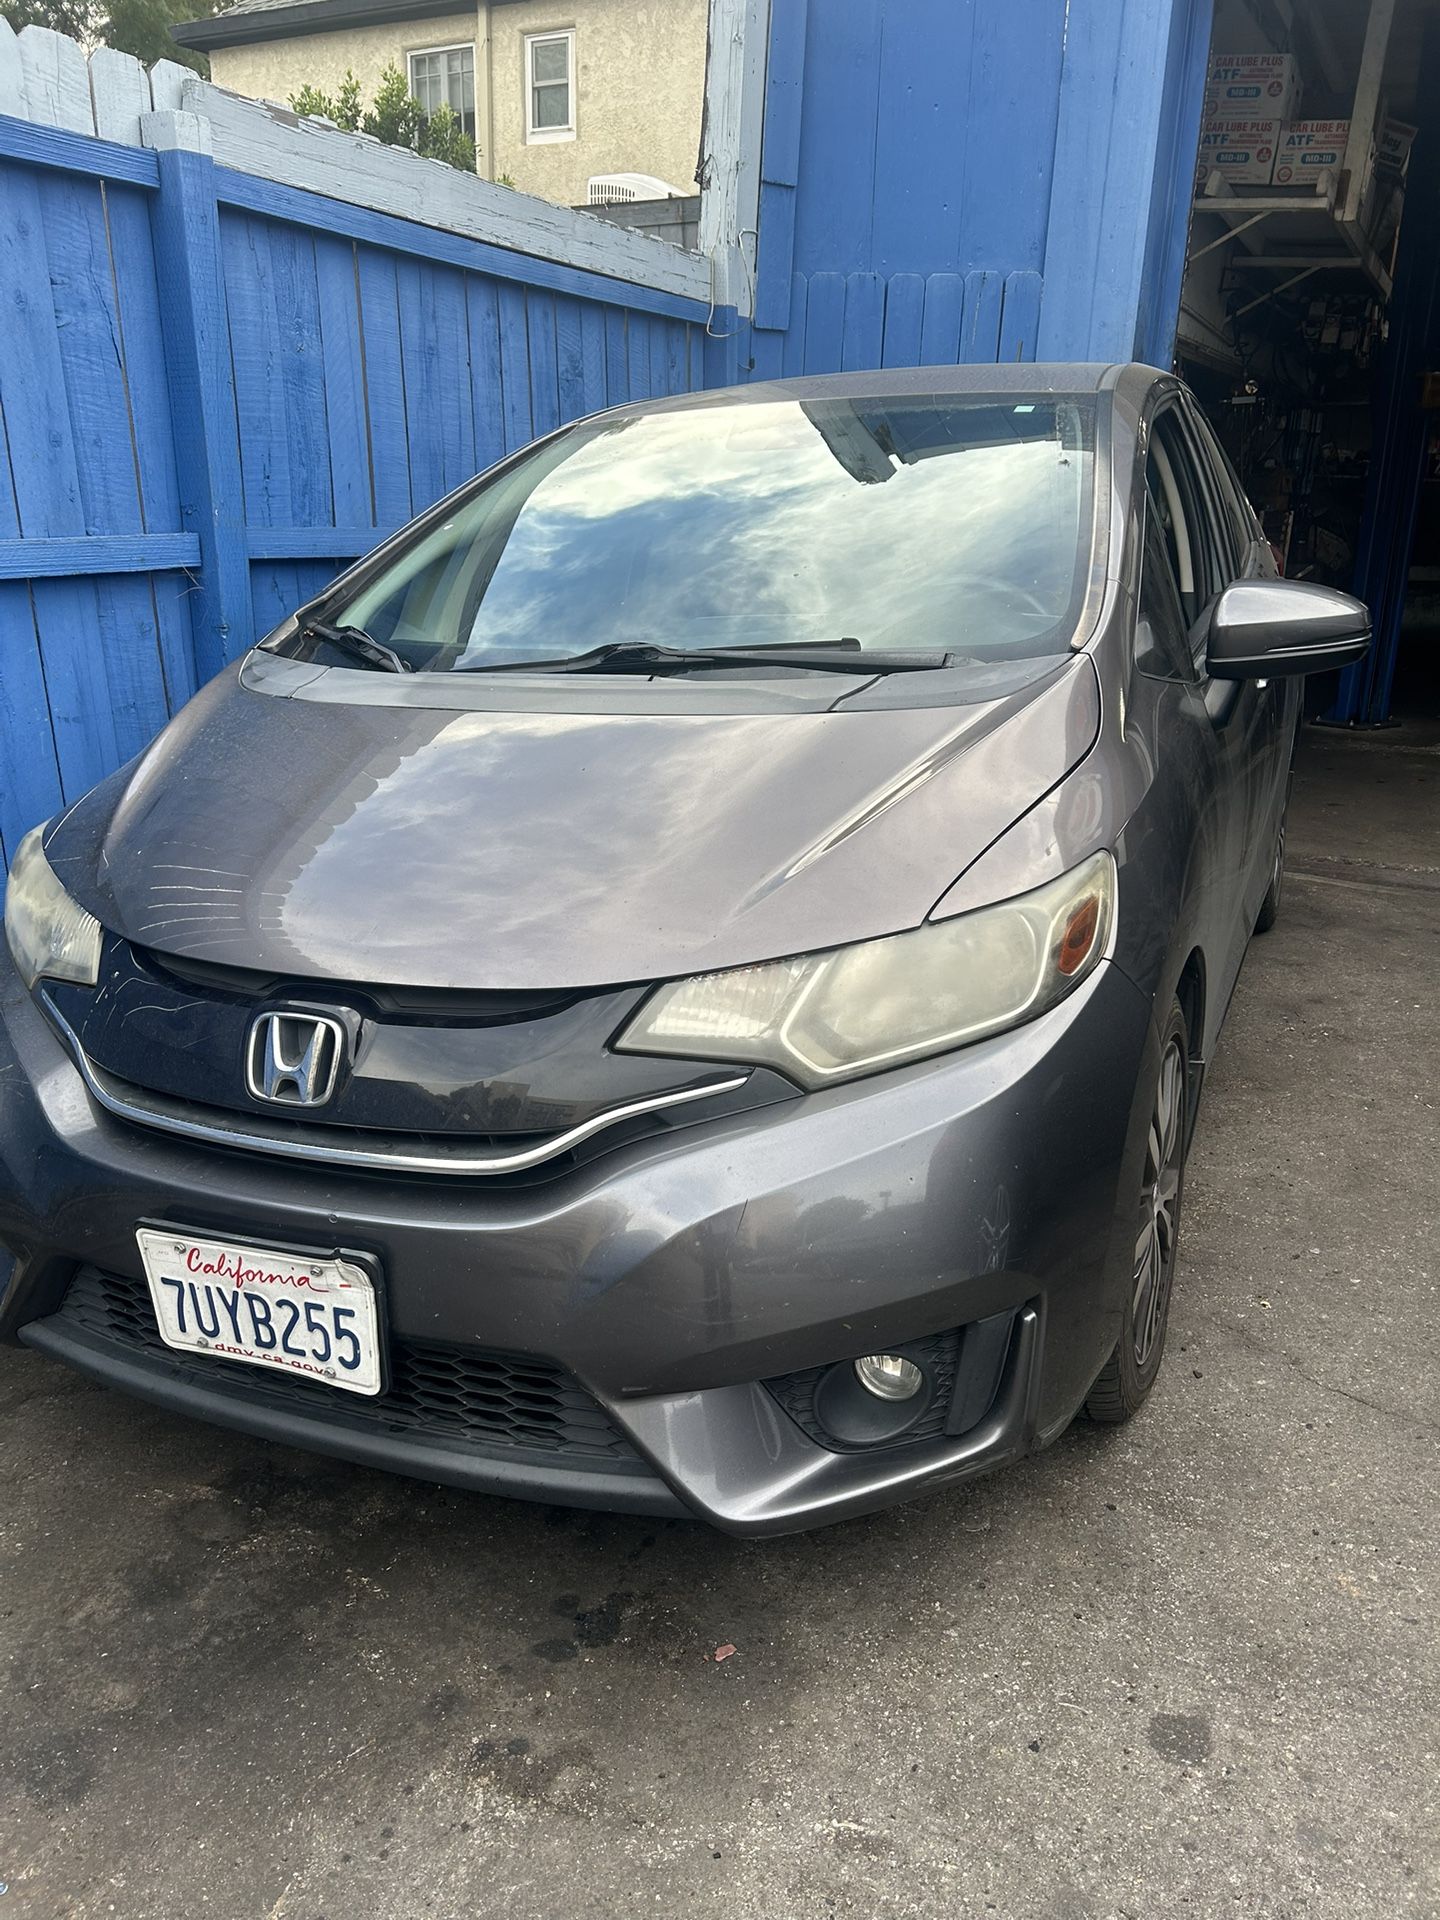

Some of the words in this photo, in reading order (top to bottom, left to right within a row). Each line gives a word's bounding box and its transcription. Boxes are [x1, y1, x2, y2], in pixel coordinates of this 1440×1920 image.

[1215, 56, 1233, 67] CAR
[1236, 56, 1259, 67] LUBE
[1260, 55, 1284, 67] PLUS
[1213, 68, 1240, 80] ATF
[1230, 88, 1257, 97] MD-III
[1205, 122, 1223, 133] CAR
[1226, 122, 1248, 132] LUBE
[1250, 122, 1273, 132] PLUS
[1289, 123, 1308, 133] CAR
[1310, 123, 1334, 133] LUBE
[1335, 122, 1350, 132] PL
[1202, 133, 1229, 145] ATF
[1286, 134, 1315, 146] ATF
[1220, 153, 1246, 161] MD-III
[1305, 154, 1332, 163] MD-III
[186, 1247, 330, 1293] California
[160, 1277, 361, 1370] 7UYB255
